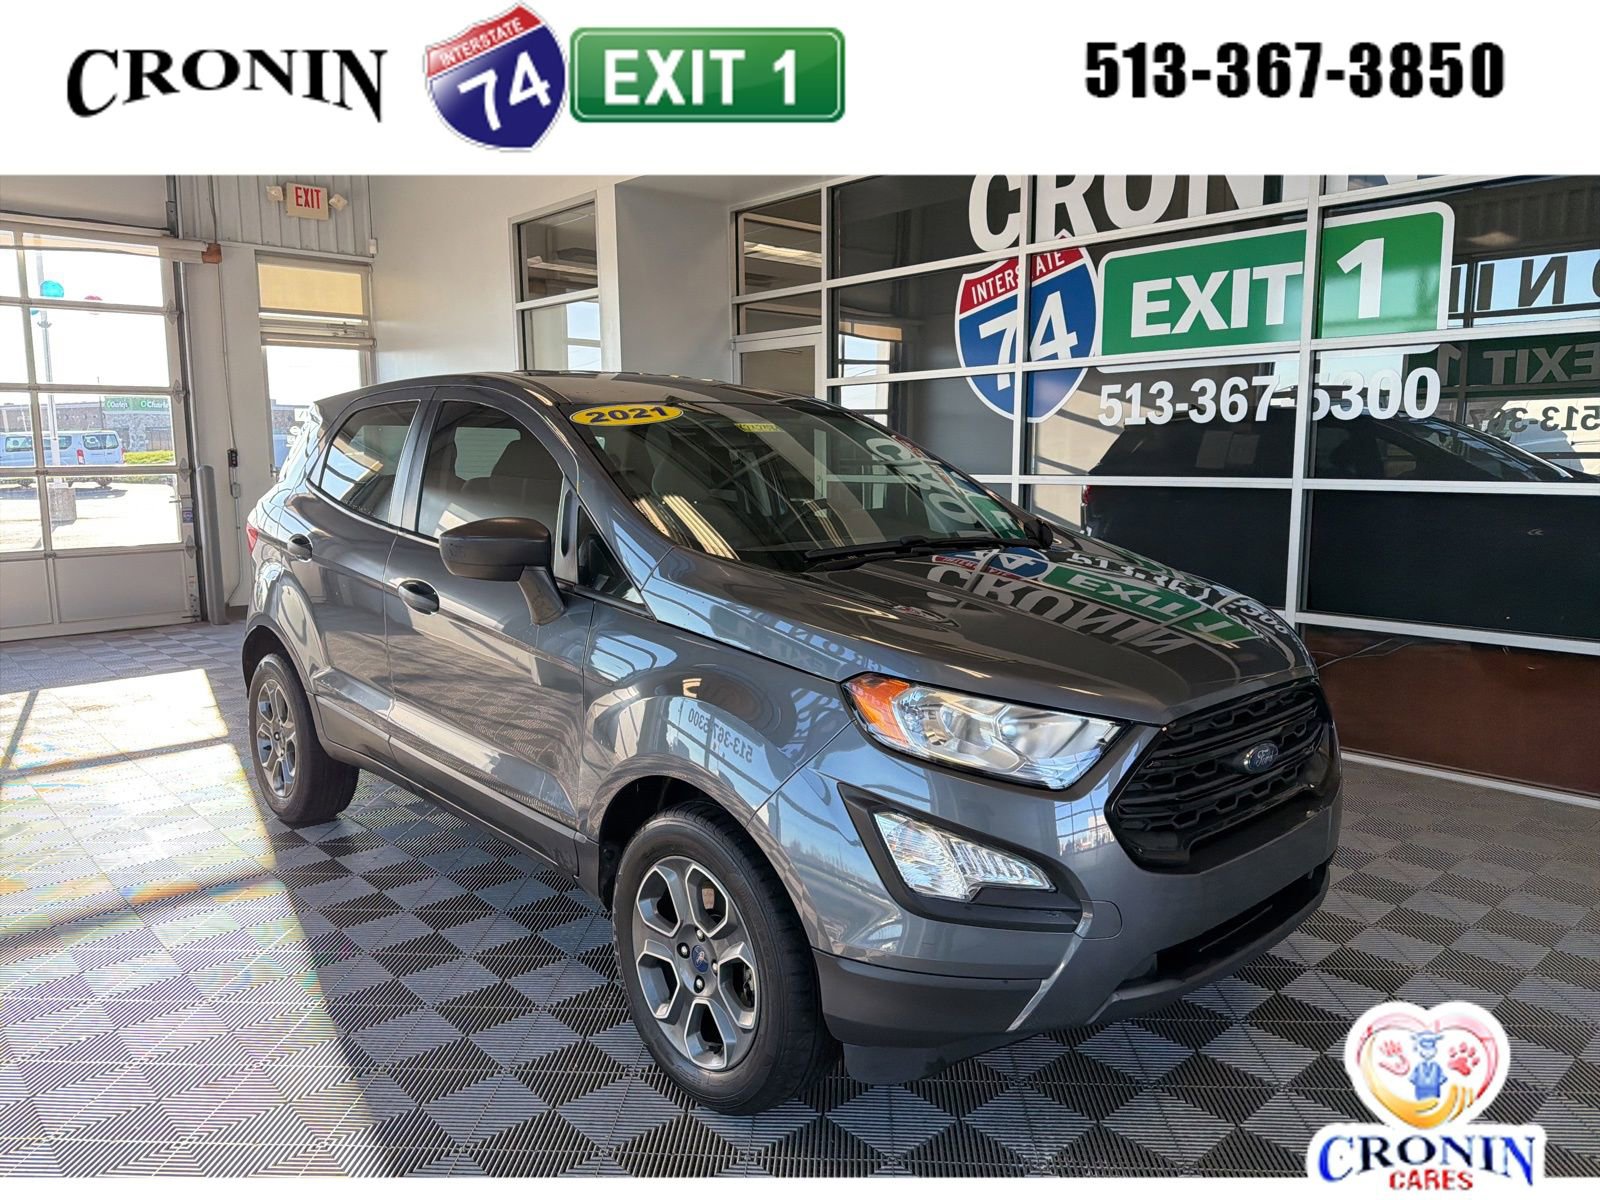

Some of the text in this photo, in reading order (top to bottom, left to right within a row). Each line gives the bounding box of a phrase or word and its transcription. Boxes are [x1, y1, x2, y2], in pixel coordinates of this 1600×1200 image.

[295, 186, 321, 209] EXIT
[968, 175, 1417, 252] CRO
[971, 251, 1066, 305] INTERATE
[1131, 261, 1304, 338] EXIT
[1337, 237, 1385, 319] 1
[978, 290, 1079, 391] 74
[587, 406, 669, 423] 2021
